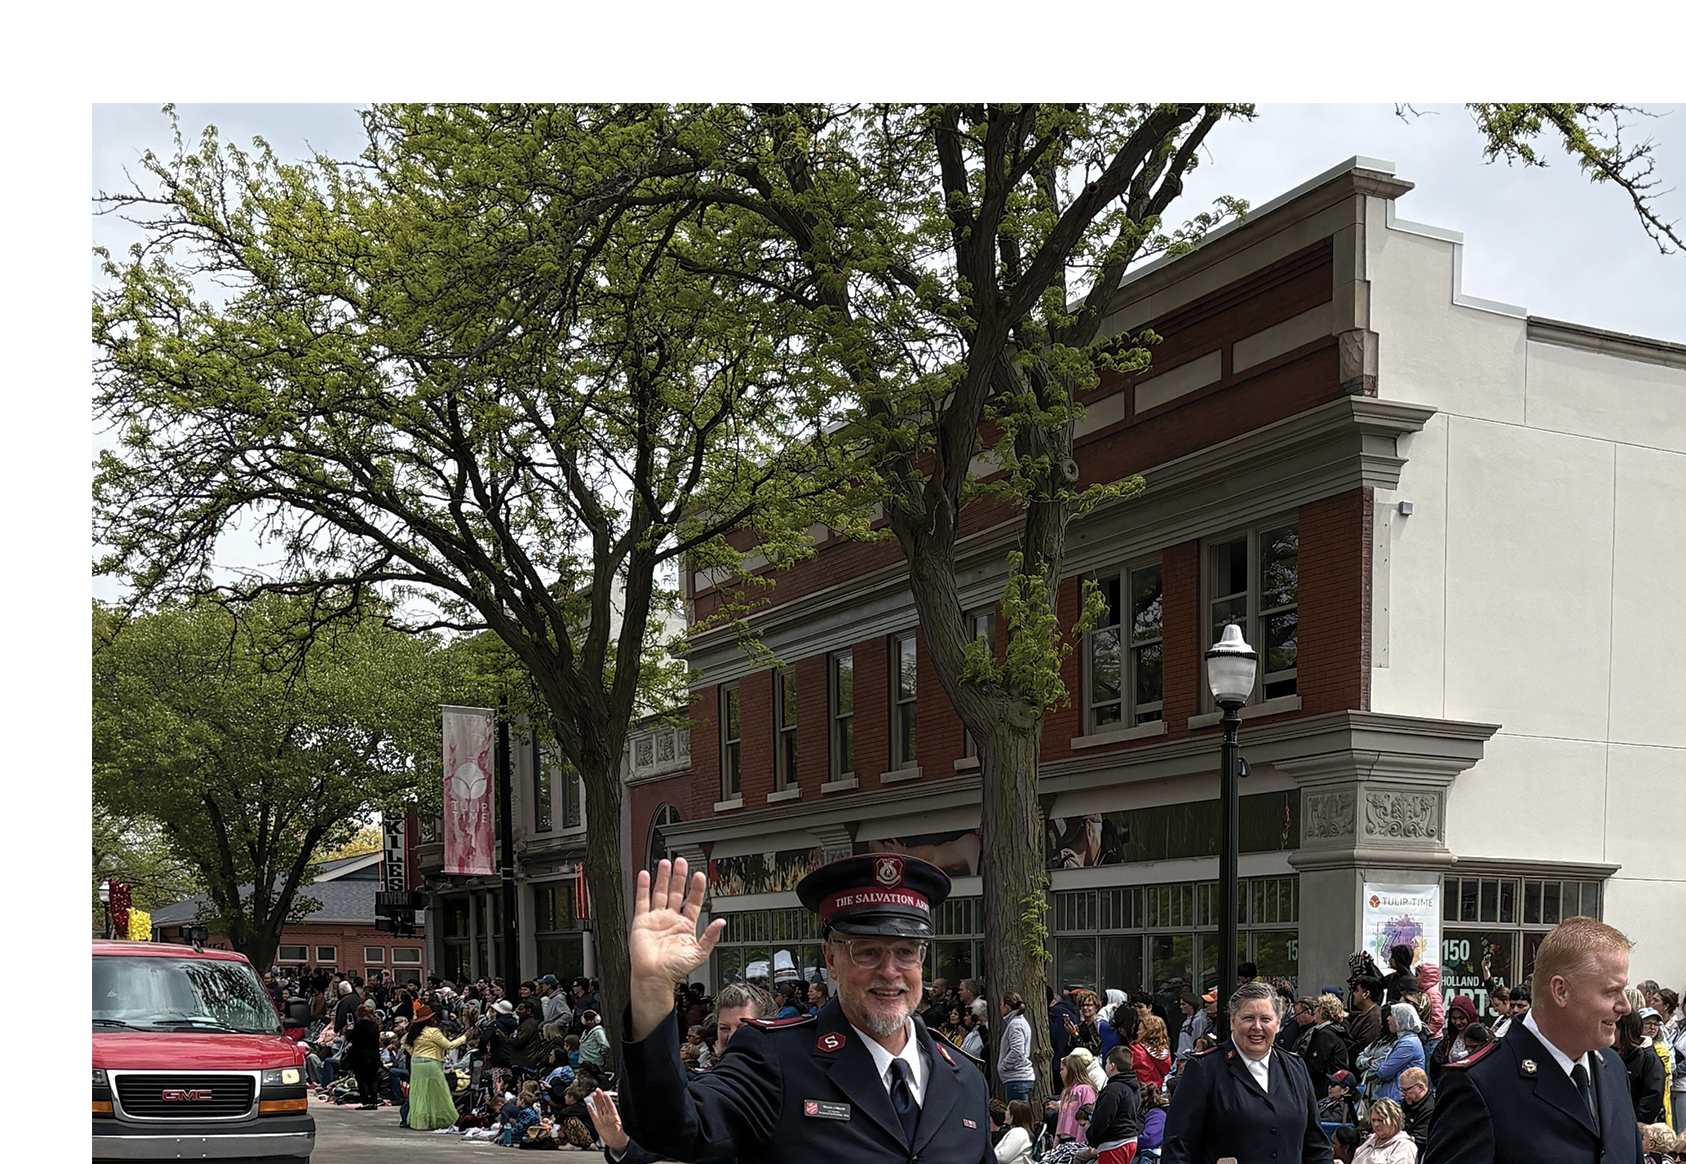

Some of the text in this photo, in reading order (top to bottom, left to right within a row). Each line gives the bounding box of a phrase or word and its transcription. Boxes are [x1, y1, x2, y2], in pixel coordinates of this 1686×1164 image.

[451, 800, 488, 812] TULIP
[452, 811, 487, 823] TIME
[384, 808, 404, 891] KILES
[836, 896, 854, 908] THE
[855, 893, 914, 908] SALVATION
[1382, 897, 1433, 907] TULIP TIME
[1441, 939, 1470, 961] 150
[1440, 976, 1480, 987] HOLLAND
[824, 1035, 839, 1049] S
[1524, 1060, 1535, 1071] S
[162, 1089, 212, 1101] GMC
